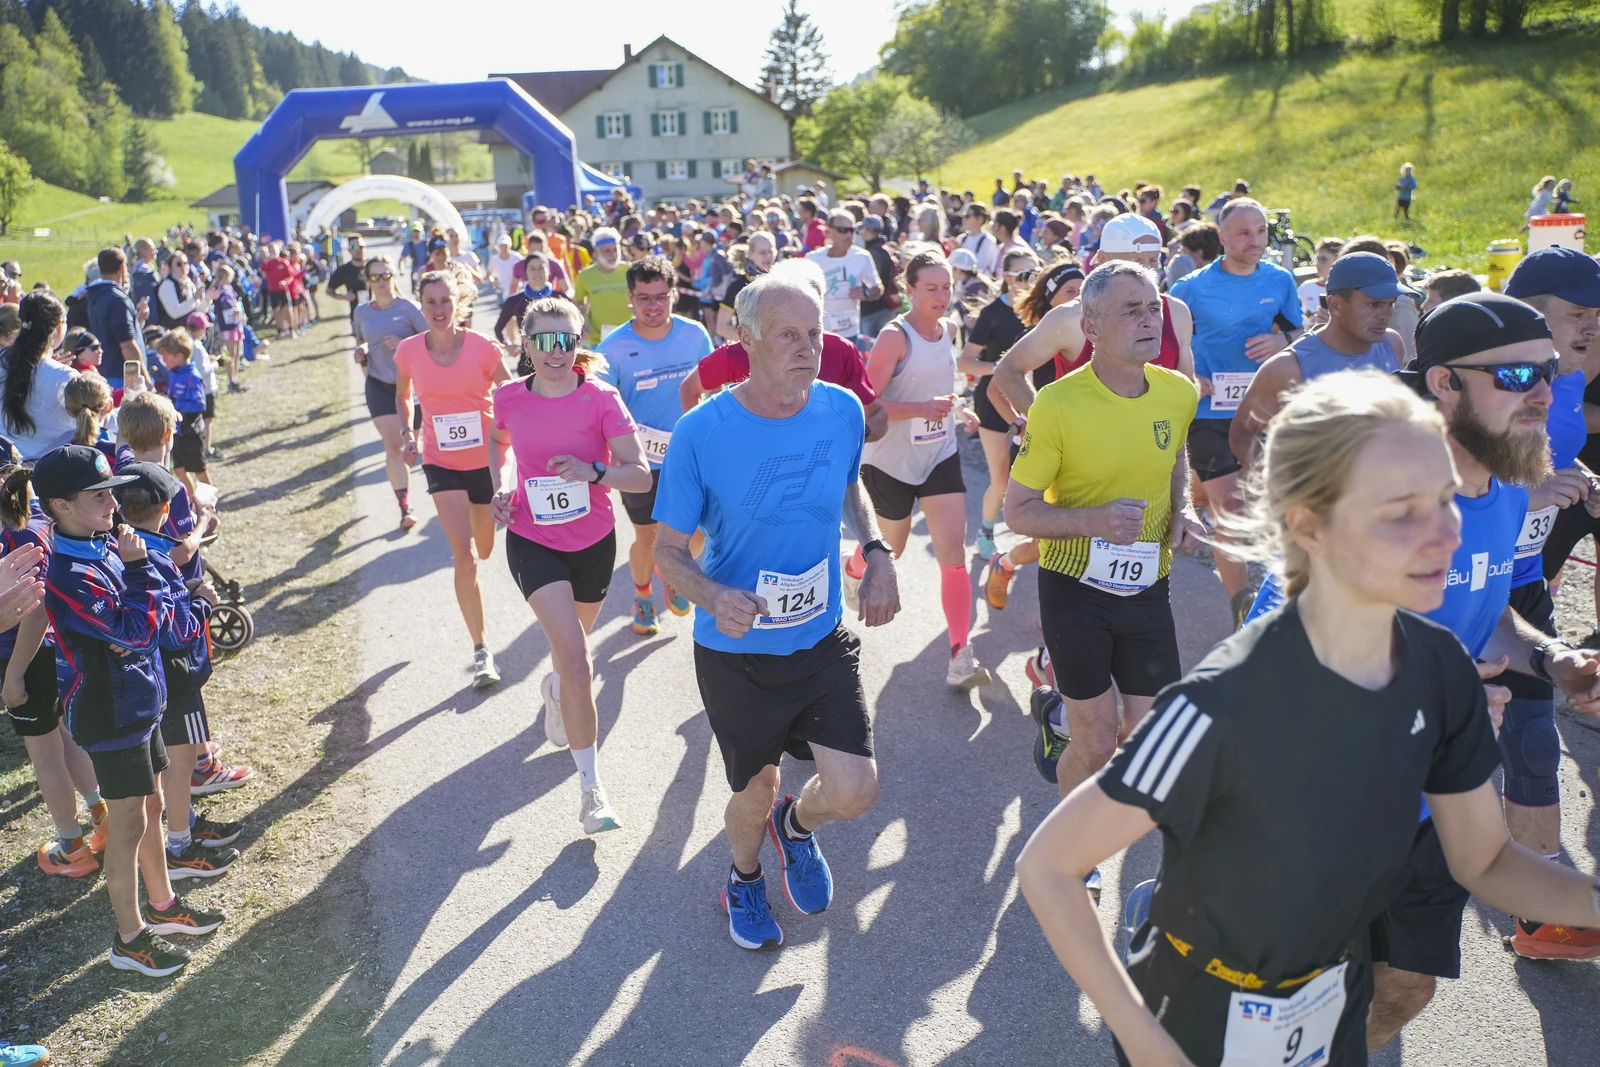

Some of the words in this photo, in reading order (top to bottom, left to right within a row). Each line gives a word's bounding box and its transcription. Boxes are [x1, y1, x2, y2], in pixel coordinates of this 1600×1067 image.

[1224, 386, 1248, 399] 127
[450, 426, 467, 440] 59
[646, 440, 668, 454] 118
[546, 492, 569, 510] 16
[1529, 515, 1550, 540] 33
[1108, 559, 1143, 581] 119
[778, 586, 815, 613] 124
[1283, 1026, 1303, 1064] 9
